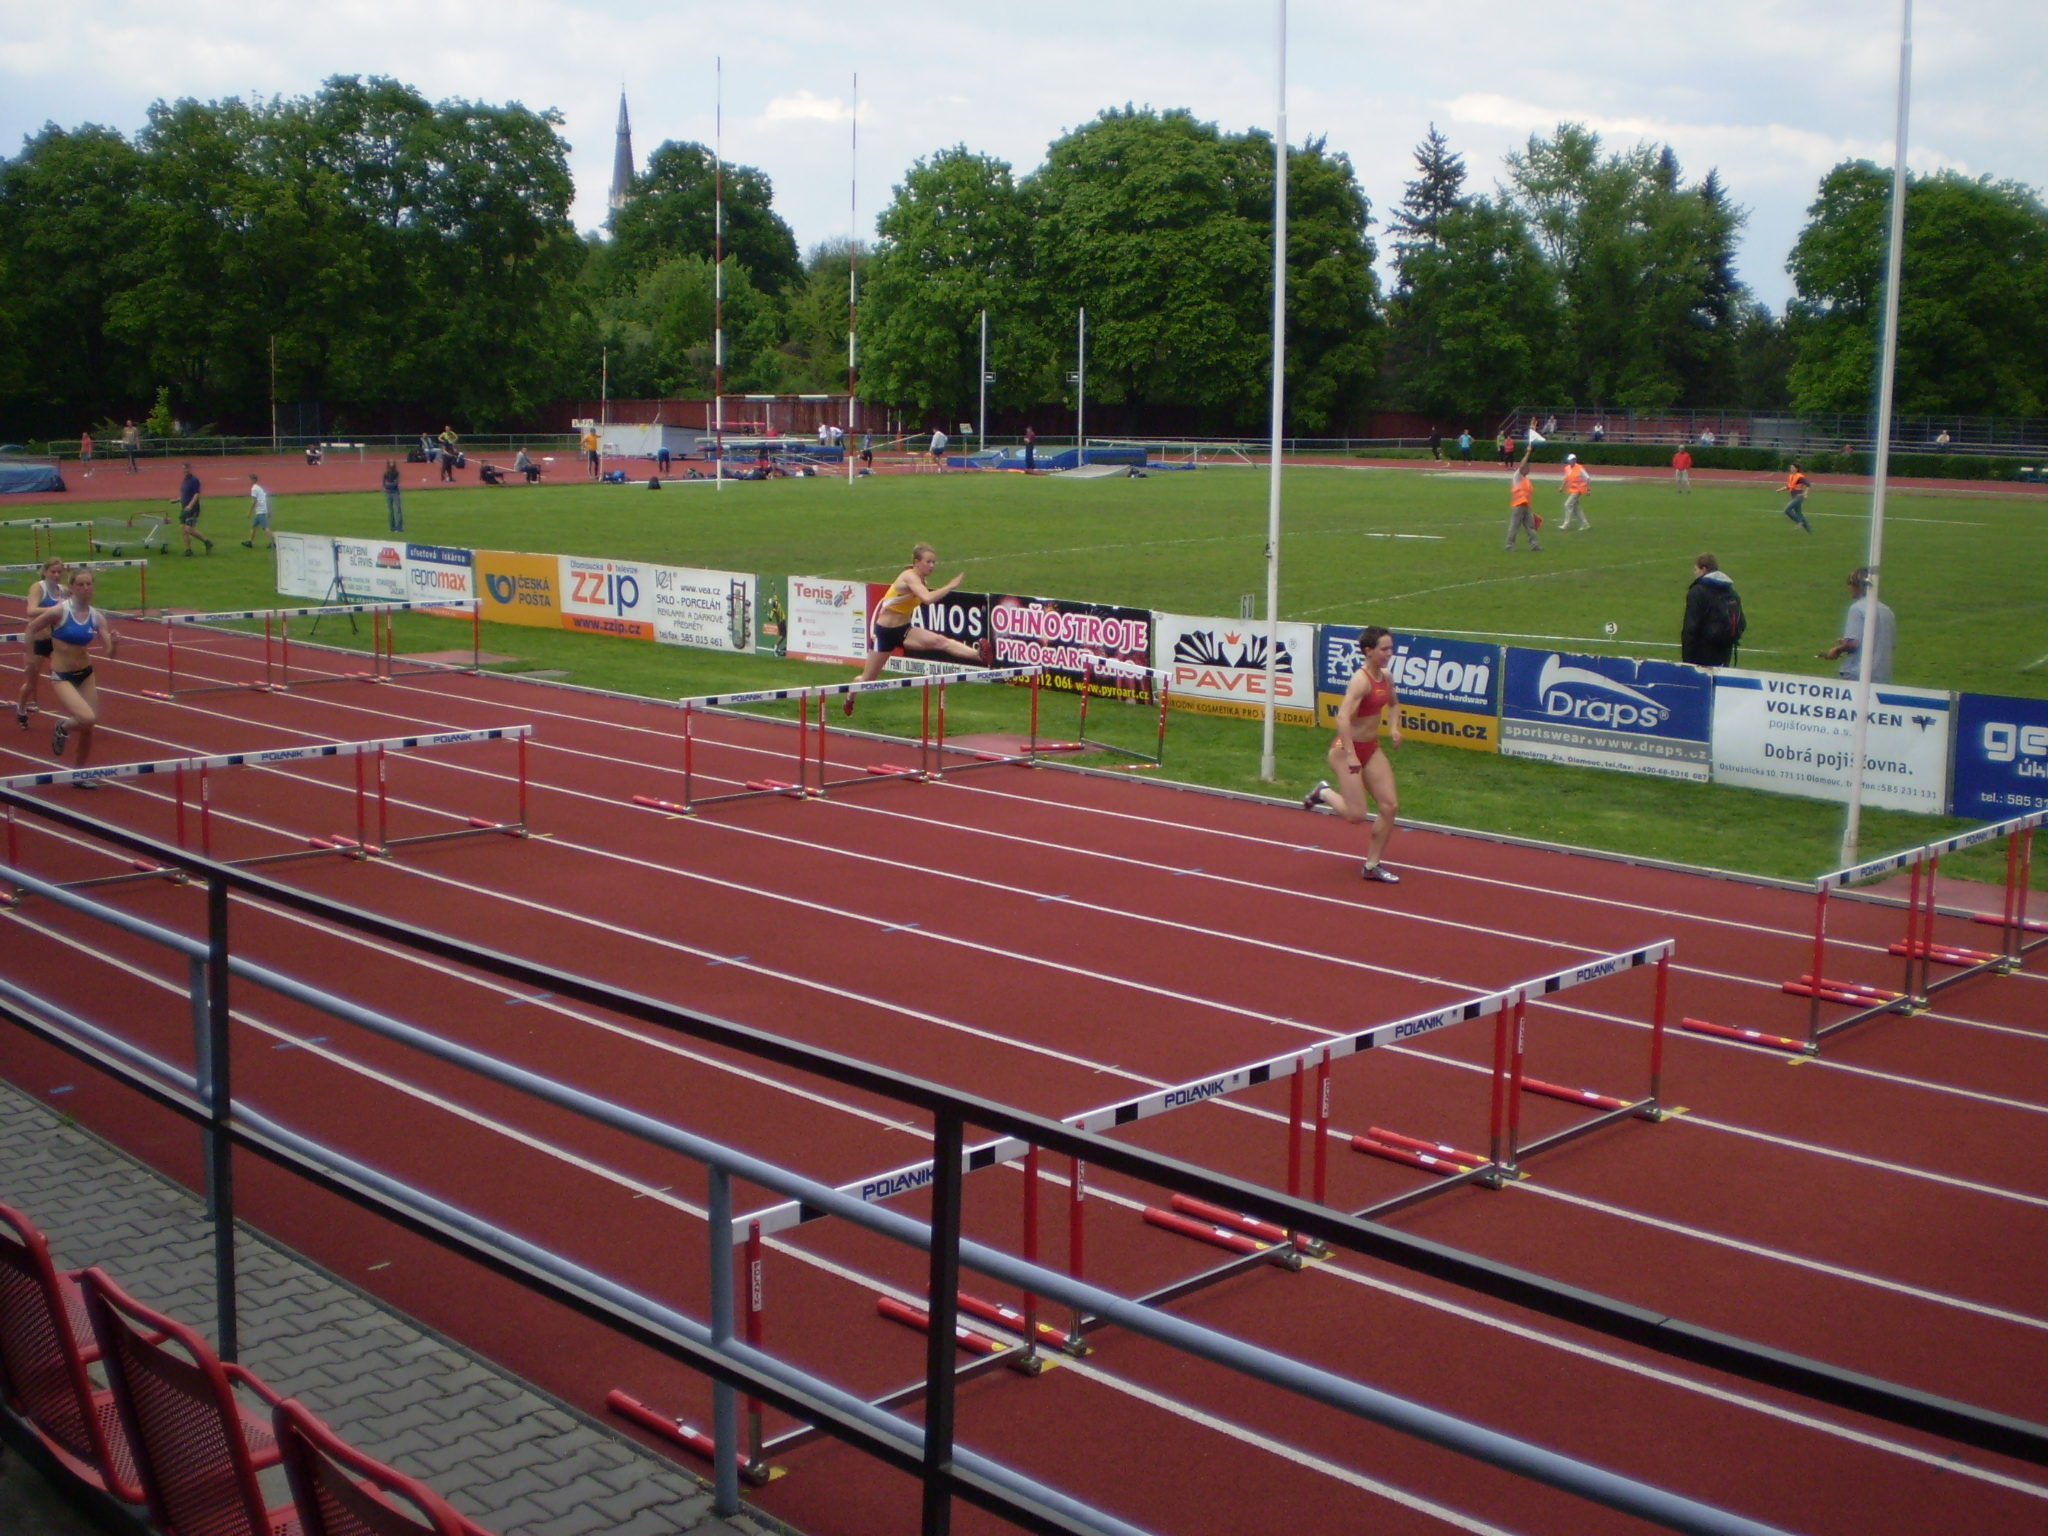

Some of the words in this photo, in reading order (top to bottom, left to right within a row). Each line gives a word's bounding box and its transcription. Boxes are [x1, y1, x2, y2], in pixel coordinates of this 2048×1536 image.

[570, 560, 604, 571] Olomoucká
[615, 563, 638, 574] televize
[411, 568, 467, 592] repromax
[518, 574, 551, 591] ČESKÁ
[519, 591, 552, 607] POŠTA
[571, 565, 639, 616] zzip
[680, 584, 721, 597] www.vea.cz
[794, 582, 833, 600] Tenis
[656, 593, 675, 605] SKLO
[681, 596, 721, 611] PORCELÁN
[815, 598, 833, 606] PLUS
[573, 617, 642, 635] www.zzip.cz
[991, 603, 1149, 654] OHŇOSTROJE
[1607, 622, 1616, 634] 3
[1075, 682, 1150, 701] ww.pyroart.cz
[1175, 667, 1294, 697] PAVES
[1767, 680, 1853, 702] VICTORIA
[731, 692, 763, 703] POLANIK
[1409, 689, 1444, 700] software
[1449, 692, 1488, 706] hardware
[1197, 703, 1240, 716] KOSMETIKA
[1242, 709, 1259, 718] PRO
[1262, 710, 1282, 722] VŠE
[1283, 712, 1313, 725] ZDRAVÍ
[1547, 690, 1659, 728] Draps
[1766, 700, 1903, 727] VOLKSBANKEN
[1326, 704, 1488, 740] w.ision.cz
[433, 733, 473, 744] POLANIK
[1505, 725, 1586, 747] sportswear
[261, 750, 304, 762] POLANIK
[1764, 743, 1812, 765] Dobrá
[72, 767, 118, 780] POLANIK
[1719, 763, 1765, 776] Ostružnická
[1780, 770, 1794, 780] 771
[1901, 786, 1918, 797] 231
[1921, 789, 1937, 800] 131
[1981, 792, 2003, 804] tel.:
[2007, 794, 2031, 807] 585
[1576, 961, 1616, 983] POLANIK
[1395, 1014, 1444, 1039] POLANIK
[1164, 1078, 1225, 1109] POLANIK
